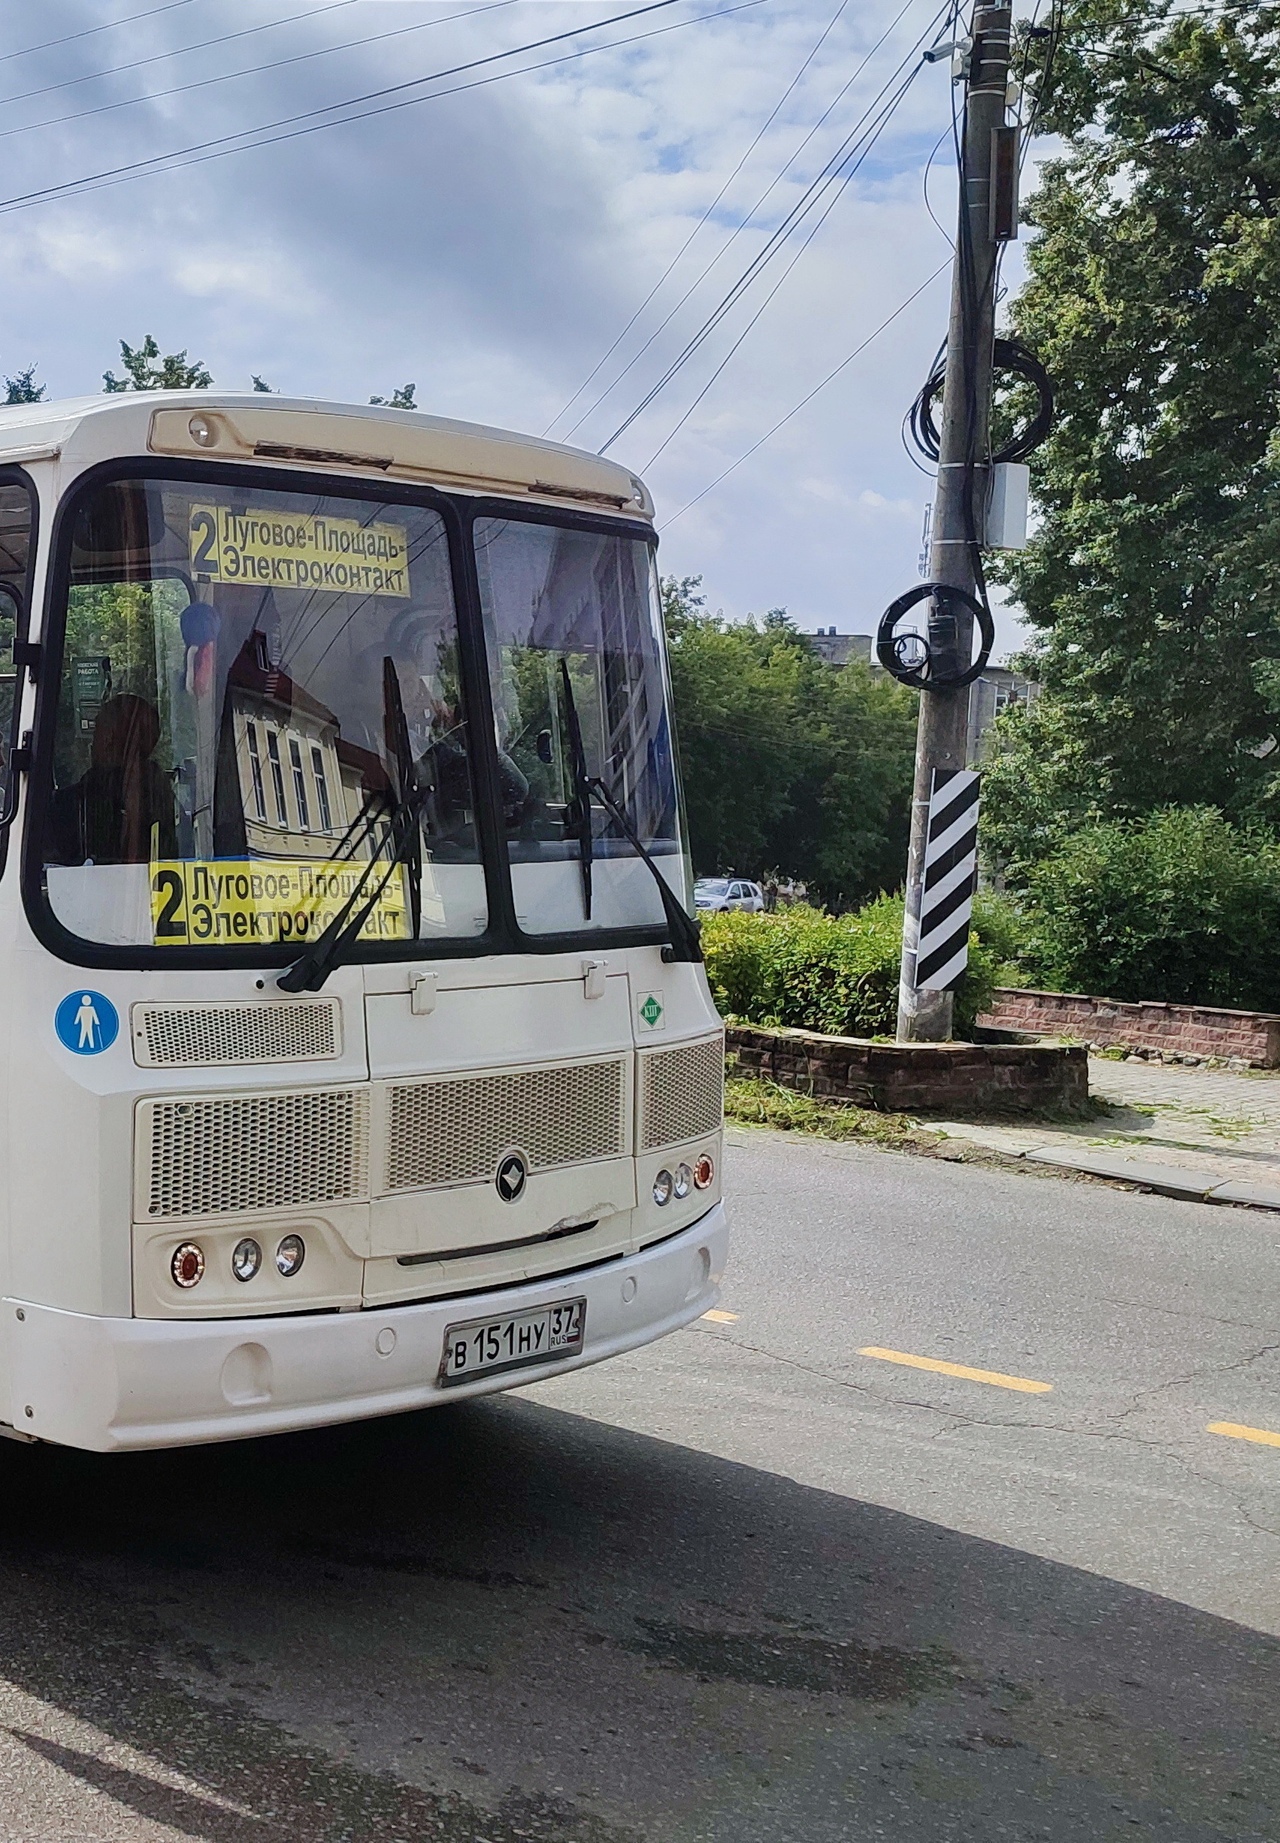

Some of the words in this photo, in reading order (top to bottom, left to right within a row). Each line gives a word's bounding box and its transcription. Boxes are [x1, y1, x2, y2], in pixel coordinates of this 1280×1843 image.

[190, 510, 219, 574] 2
[223, 545, 405, 592] Электроконтакт
[151, 869, 187, 937] 2
[191, 903, 400, 940] Электрокоакт
[550, 1333, 567, 1347] RUS
[552, 1306, 574, 1335] 37
